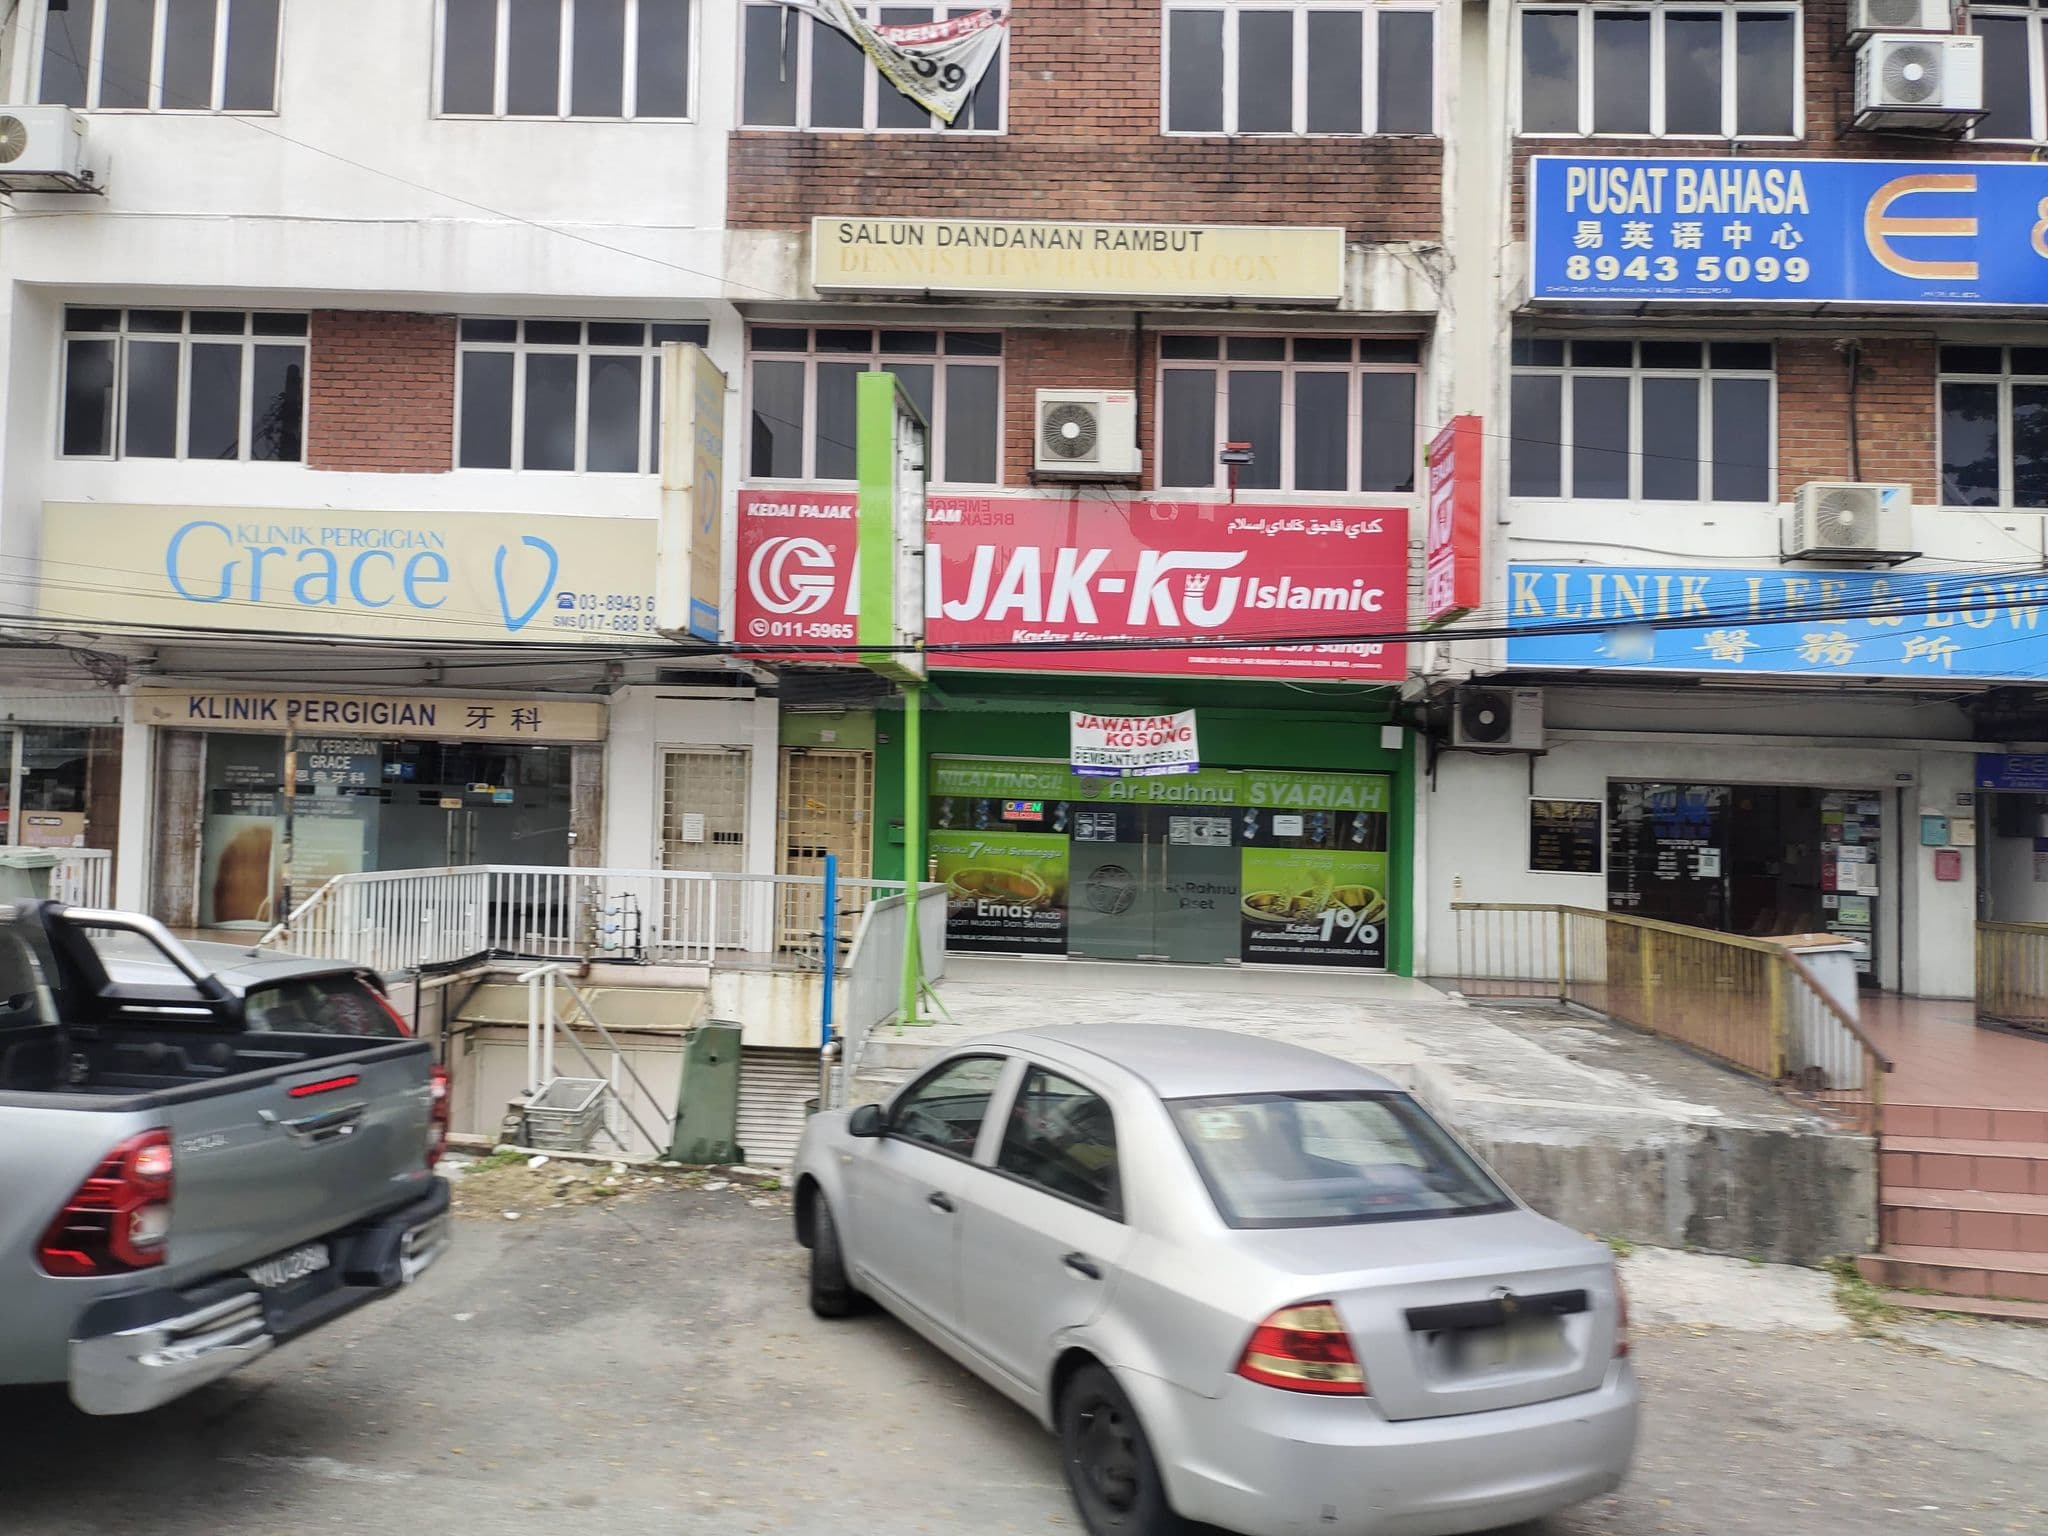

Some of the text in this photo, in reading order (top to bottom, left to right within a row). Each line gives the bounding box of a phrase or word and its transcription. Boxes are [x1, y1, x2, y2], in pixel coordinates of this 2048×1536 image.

[1566, 166, 1810, 215] PUSAT BAHASA
[838, 222, 1204, 252] SALUN DANDANAN RAMBUT
[1572, 220, 1805, 251] 易英语中心
[1863, 173, 1980, 281] E
[1565, 254, 1811, 283] 8943 5099
[747, 503, 963, 523] KEDAI PAJAK LAM
[236, 524, 446, 549] KLINIK PERGIGIAN
[166, 519, 450, 610] Grace
[843, 541, 1248, 628] JAK-KU
[1243, 576, 1385, 613] Islamic
[579, 593, 656, 612] 03-8943 6
[1511, 571, 1712, 621] KLINIK
[1922, 580, 2048, 631] LOW
[553, 615, 577, 628] SMS
[577, 614, 641, 632] 017-688
[770, 621, 855, 639] 011-5965
[188, 695, 437, 727] KLINIK PERGIGIAN
[464, 705, 543, 733] 牙科
[1076, 715, 1174, 731] JAWATAN
[1105, 726, 1192, 747] KOSONG
[308, 754, 353, 770] GRACE
[1074, 749, 1194, 766] PEMBANTU OPERASI
[1109, 780, 1235, 803] Ar-Rahnu
[1250, 781, 1383, 809] SYARIAH
[1005, 800, 1042, 812] OPEN
[968, 841, 986, 859] 7
[976, 897, 1034, 919] Emas
[1316, 907, 1381, 945] 1%
